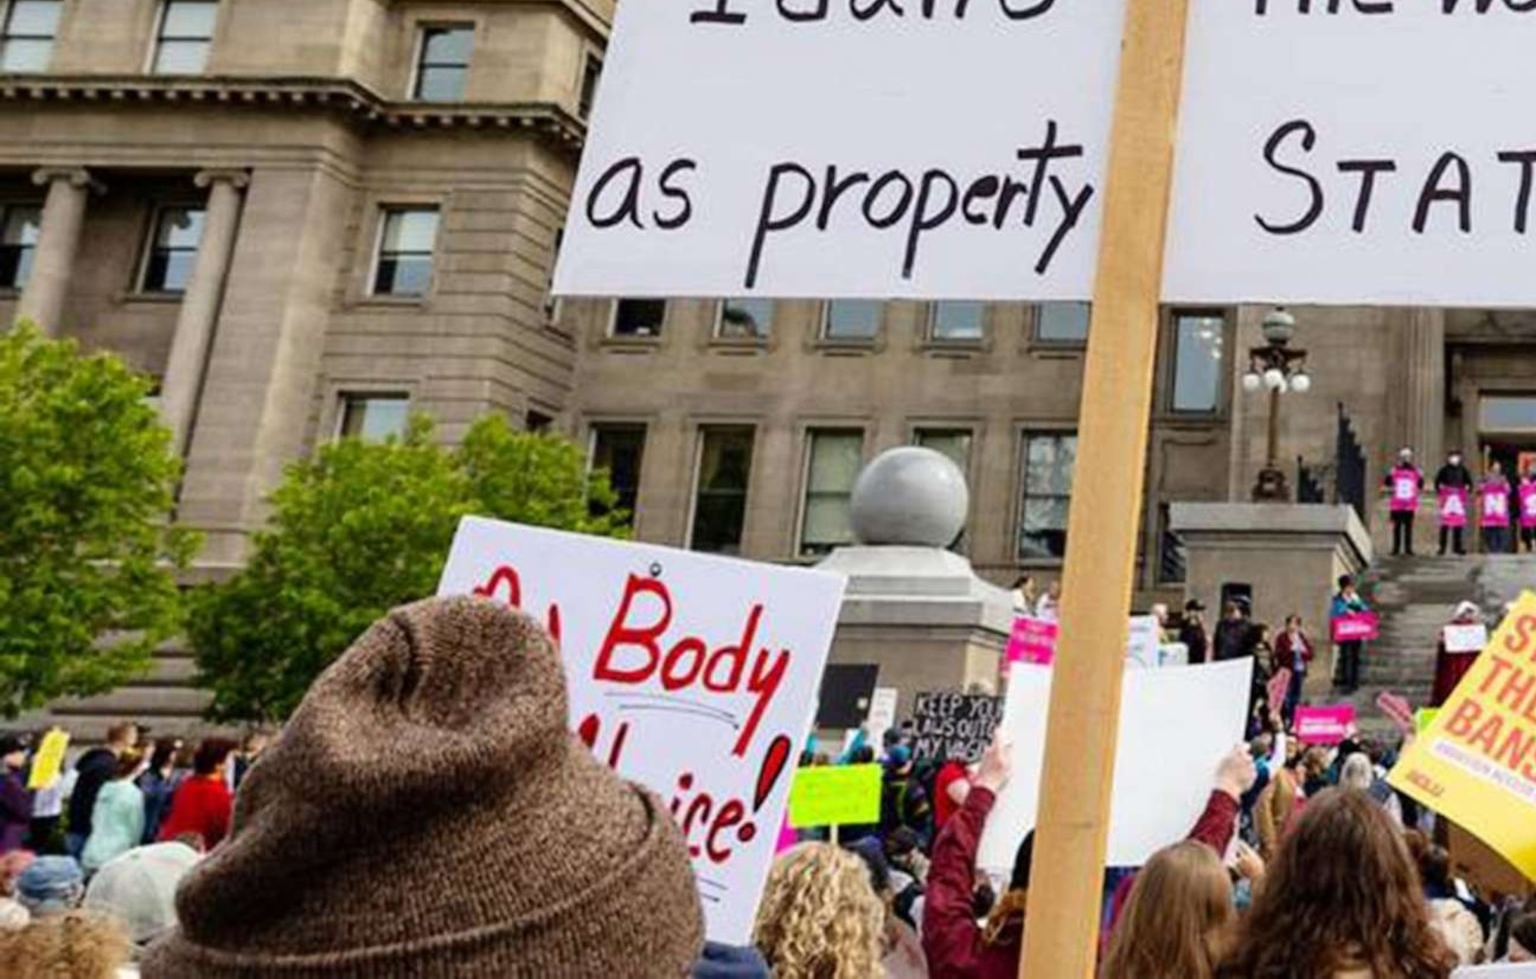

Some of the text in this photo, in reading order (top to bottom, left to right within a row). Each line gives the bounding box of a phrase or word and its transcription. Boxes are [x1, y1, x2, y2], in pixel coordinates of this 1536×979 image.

[585, 119, 1095, 290] as property
[593, 574, 790, 757] Body
[969, 697, 1002, 719] YOU
